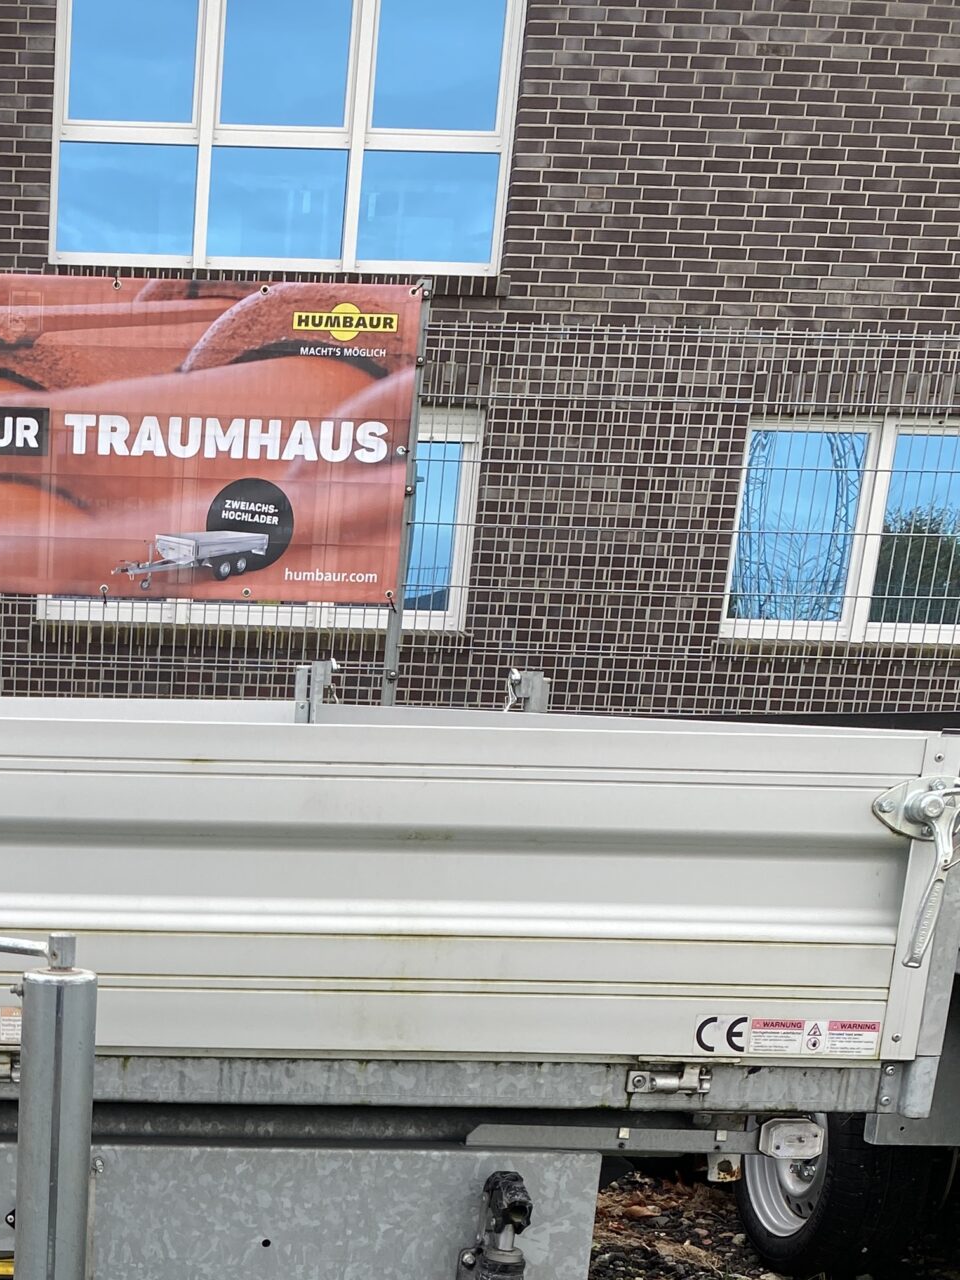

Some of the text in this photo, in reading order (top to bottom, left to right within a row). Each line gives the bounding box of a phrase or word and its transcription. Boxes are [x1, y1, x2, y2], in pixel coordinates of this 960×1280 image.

[296, 314, 395, 330] HUMBAUR
[300, 346, 387, 358] MACHT'S MÖGLICH
[64, 413, 389, 464] TRAUMHAUS
[224, 499, 279, 514] ZWEIACHS-
[221, 509, 279, 525] HOCHLADER
[284, 567, 378, 583] humbaur.com
[696, 1016, 748, 1052] CE
